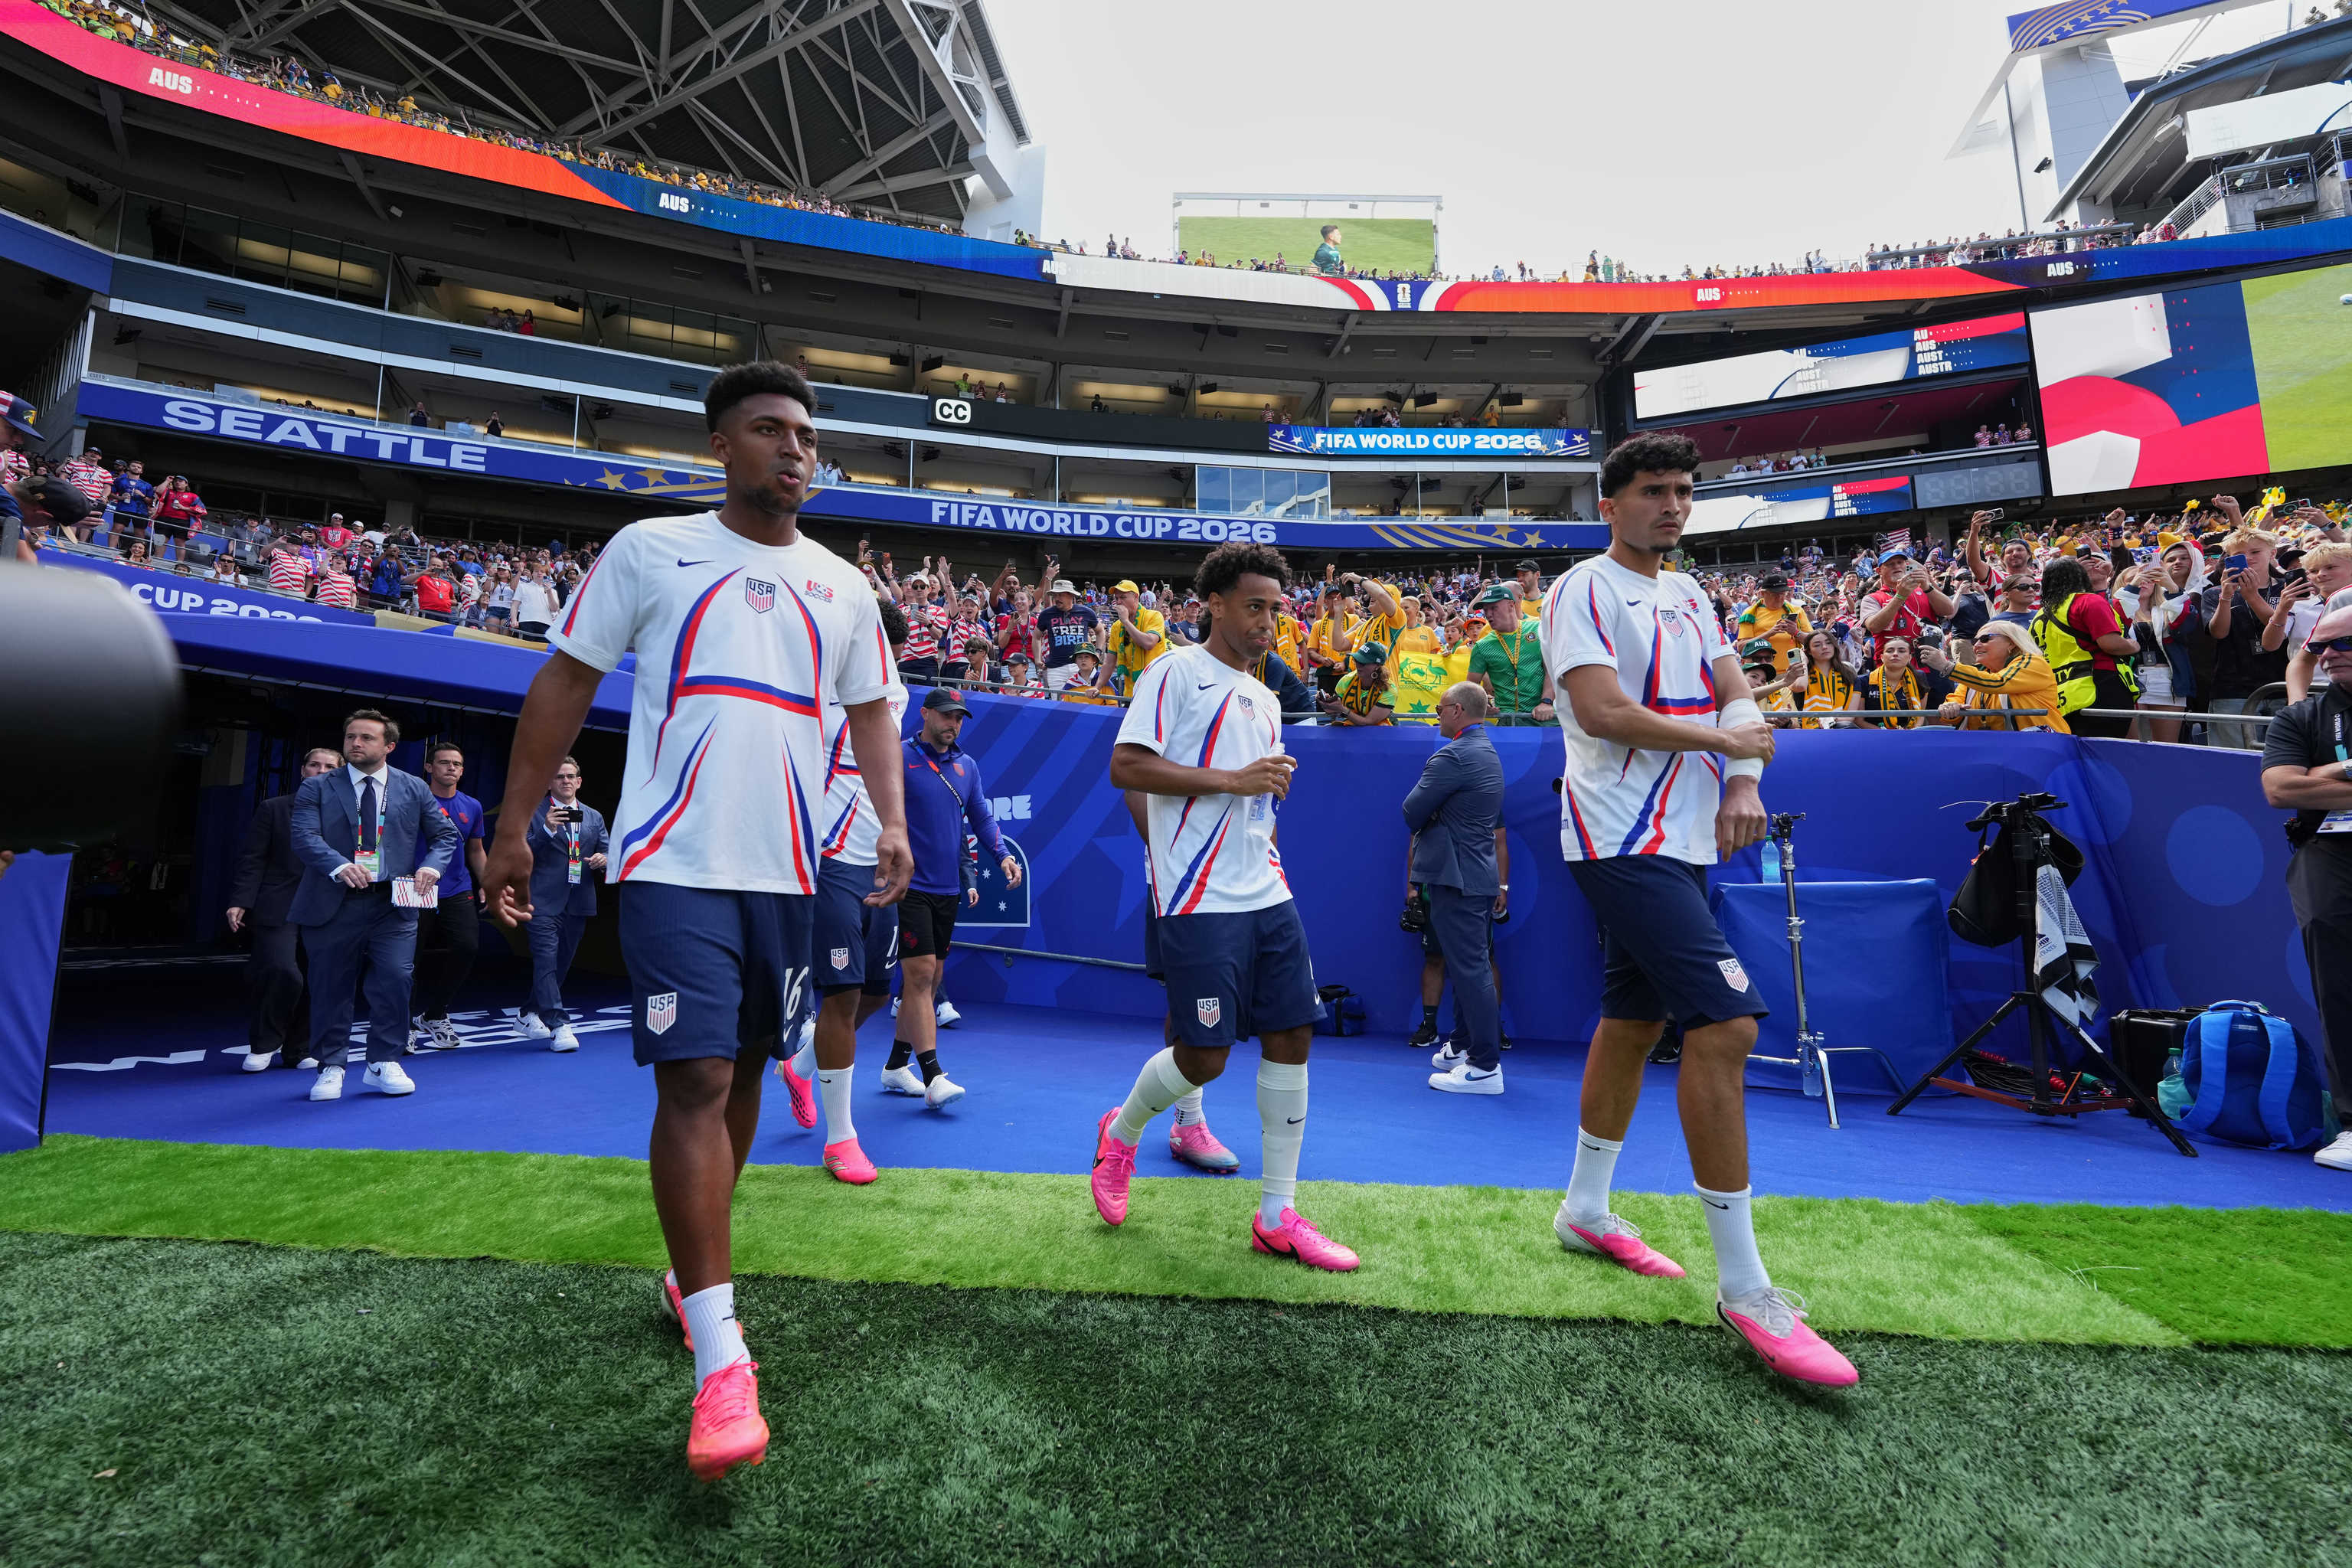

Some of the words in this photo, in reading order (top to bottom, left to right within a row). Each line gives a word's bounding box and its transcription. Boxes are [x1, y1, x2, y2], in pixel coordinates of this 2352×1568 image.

[939, 402, 967, 421] CC
[162, 400, 487, 472] SEATTLE
[1315, 433, 1356, 449] FIFA
[1356, 433, 1430, 449] WORLD
[1432, 433, 1472, 449] CUP
[1474, 434, 1542, 449] 2026
[931, 501, 997, 528] FIFA
[1001, 508, 1110, 537] WORLD
[1115, 514, 1173, 538] CUP
[1178, 518, 1277, 543] 2026
[749, 580, 773, 596] USA
[130, 583, 204, 612] CUP
[1050, 616, 1083, 626] PLAY
[1661, 612, 1676, 623] USA
[1052, 625, 1085, 636] FREE
[1054, 635, 1085, 647] BIRD
[1720, 960, 1740, 974] USA
[782, 965, 809, 1024] 16
[650, 995, 674, 1011] USA
[1198, 1000, 1218, 1011] USA
